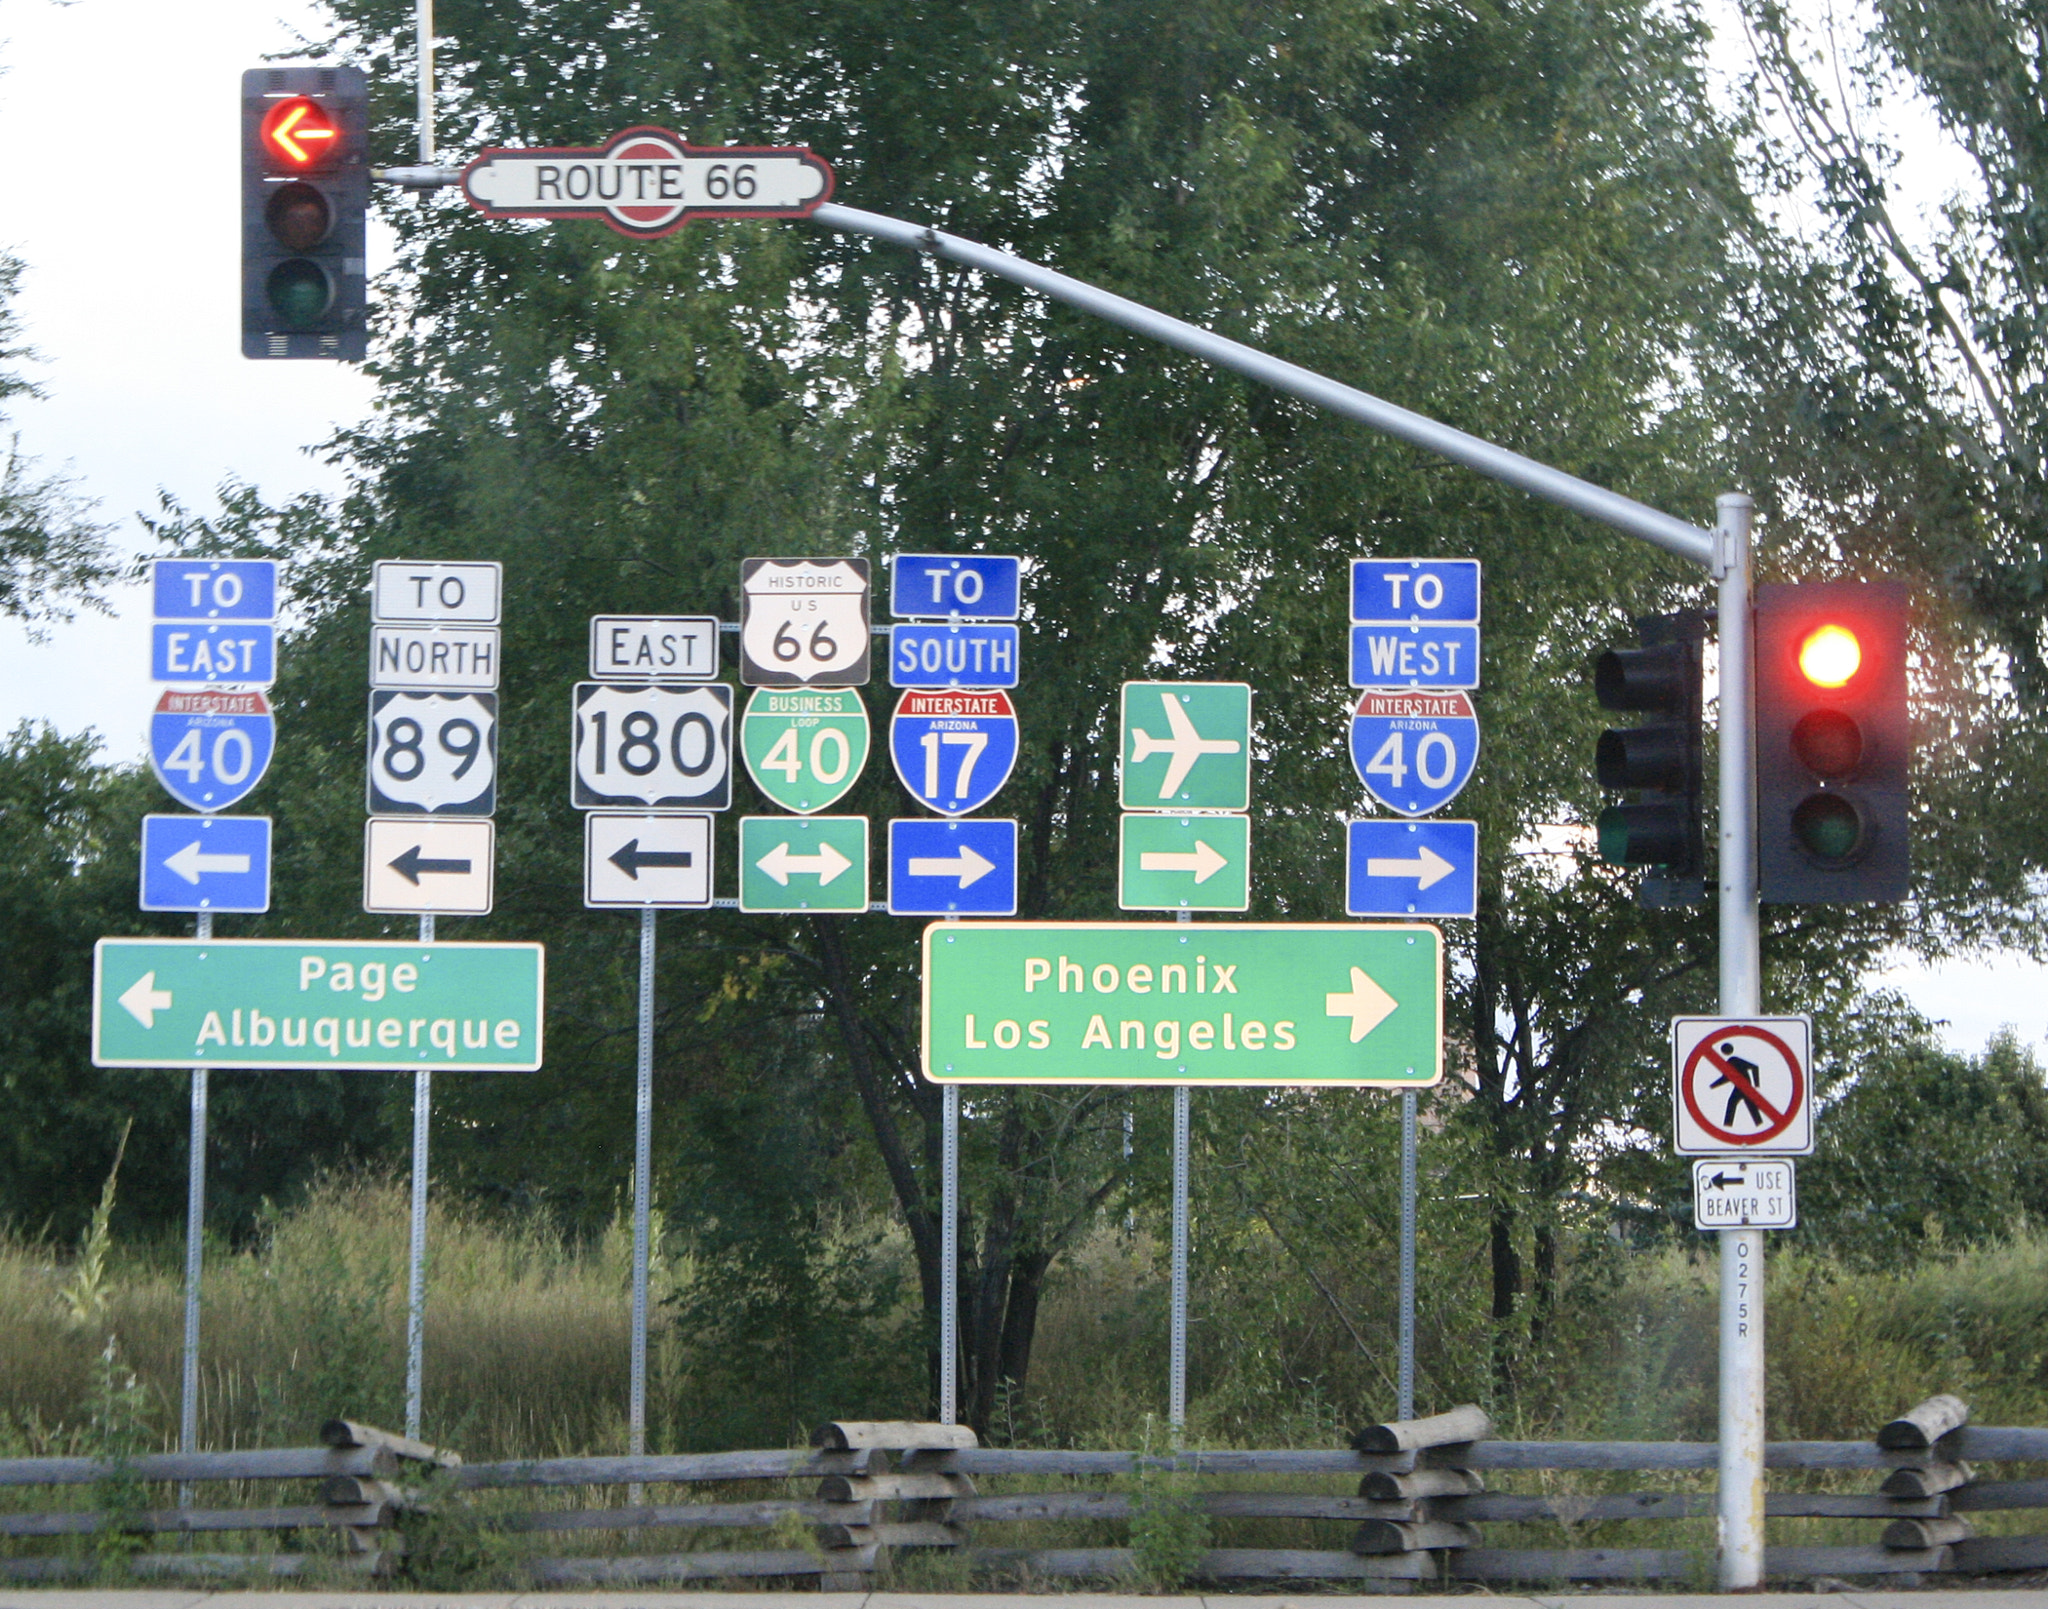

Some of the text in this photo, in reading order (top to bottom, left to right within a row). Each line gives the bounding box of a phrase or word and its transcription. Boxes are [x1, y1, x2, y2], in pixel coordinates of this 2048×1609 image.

[535, 164, 757, 200] ROUTE 66
[183, 573, 243, 608] TO
[409, 576, 466, 609] TO
[768, 576, 843, 589] HISTORIC
[925, 569, 984, 604] TO
[1384, 574, 1444, 609] TO
[167, 633, 257, 673] EAST
[379, 637, 493, 675] NORTH
[611, 628, 697, 667] EAST
[773, 620, 838, 662] 66
[898, 638, 1012, 673] SOUTH
[1368, 636, 1461, 676] WEST
[168, 696, 256, 713] INTERSTATE
[187, 717, 235, 727] ARIZONA
[768, 696, 843, 713] BUSINESS
[910, 698, 998, 714] INTERSTATE
[1370, 699, 1459, 716] INTERSTATE
[791, 718, 820, 728] LOOP
[929, 720, 978, 731] ARIZONA
[1389, 720, 1438, 731] ARIZONA
[162, 729, 253, 785] 40
[383, 717, 481, 782] 89
[591, 711, 715, 778] 180
[760, 727, 850, 785] 40
[1366, 732, 1457, 789] 40
[919, 732, 989, 799] 17
[299, 956, 419, 1002] Page
[1024, 954, 1239, 994] Phoenix
[195, 1008, 521, 1058] Albuquerque
[964, 1012, 1297, 1060] Los Angeles
[1756, 1172, 1782, 1190] USE
[1707, 1198, 1784, 1217] BEAVER ST
